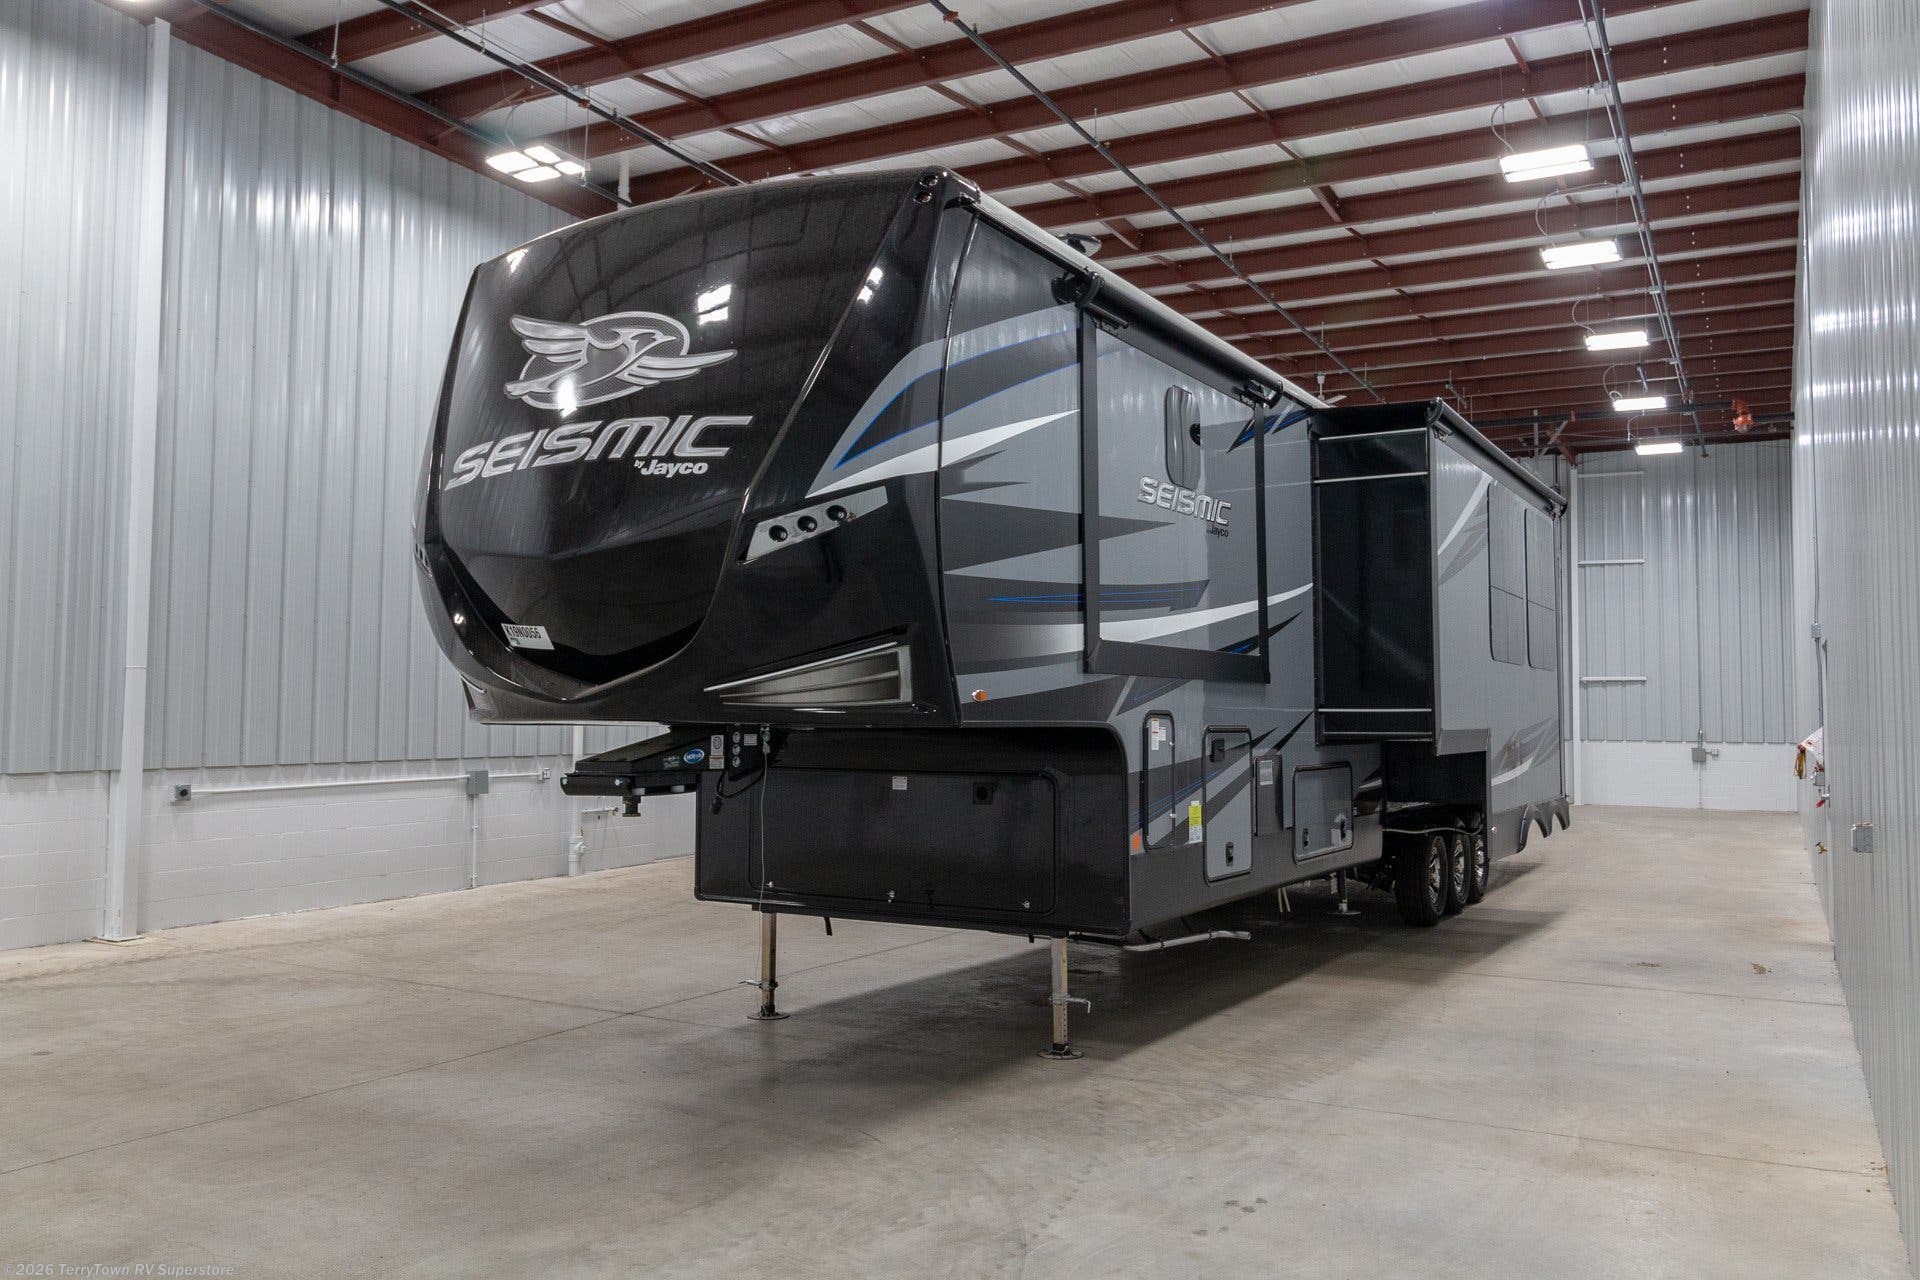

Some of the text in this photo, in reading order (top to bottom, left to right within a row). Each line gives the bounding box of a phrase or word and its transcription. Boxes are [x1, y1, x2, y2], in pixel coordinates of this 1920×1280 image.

[445, 415, 753, 491] SEISMIC
[634, 459, 709, 478] by Jayco
[1137, 476, 1232, 526] SEISMIC
